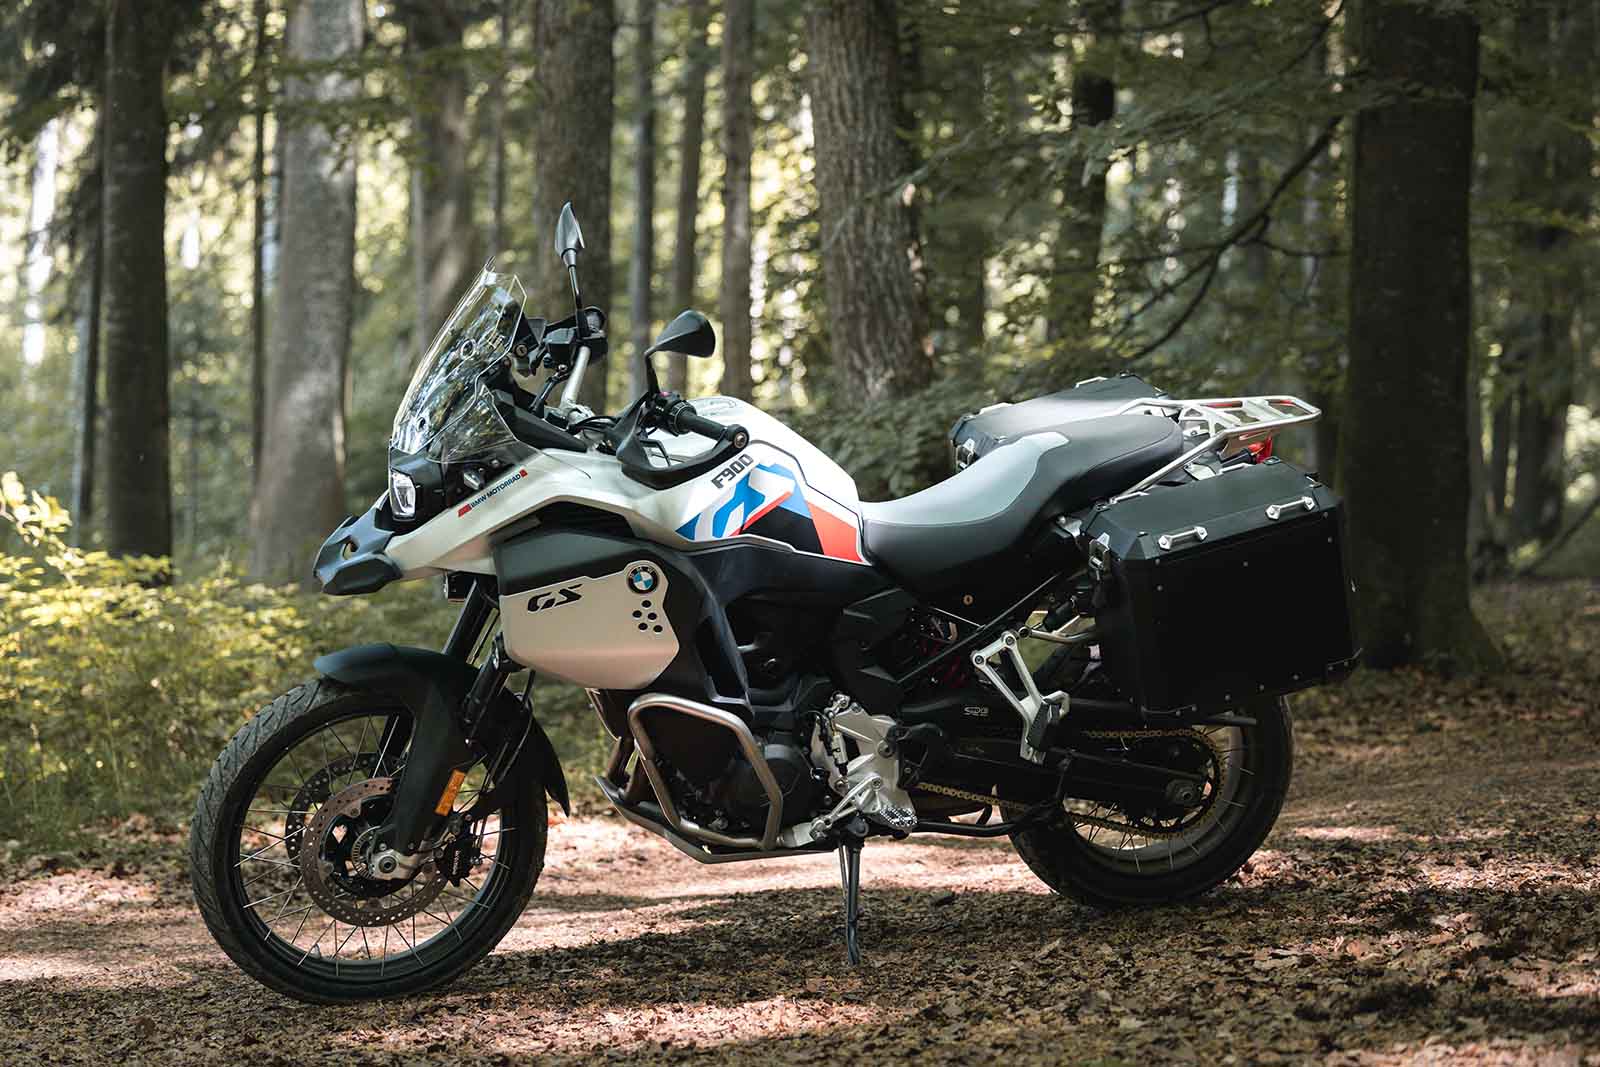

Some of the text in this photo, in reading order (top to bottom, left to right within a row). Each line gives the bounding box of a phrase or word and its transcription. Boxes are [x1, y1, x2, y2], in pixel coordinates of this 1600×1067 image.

[711, 454, 754, 489] F900
[471, 473, 521, 507] BMW MOTORRAD
[527, 583, 583, 612] GS
